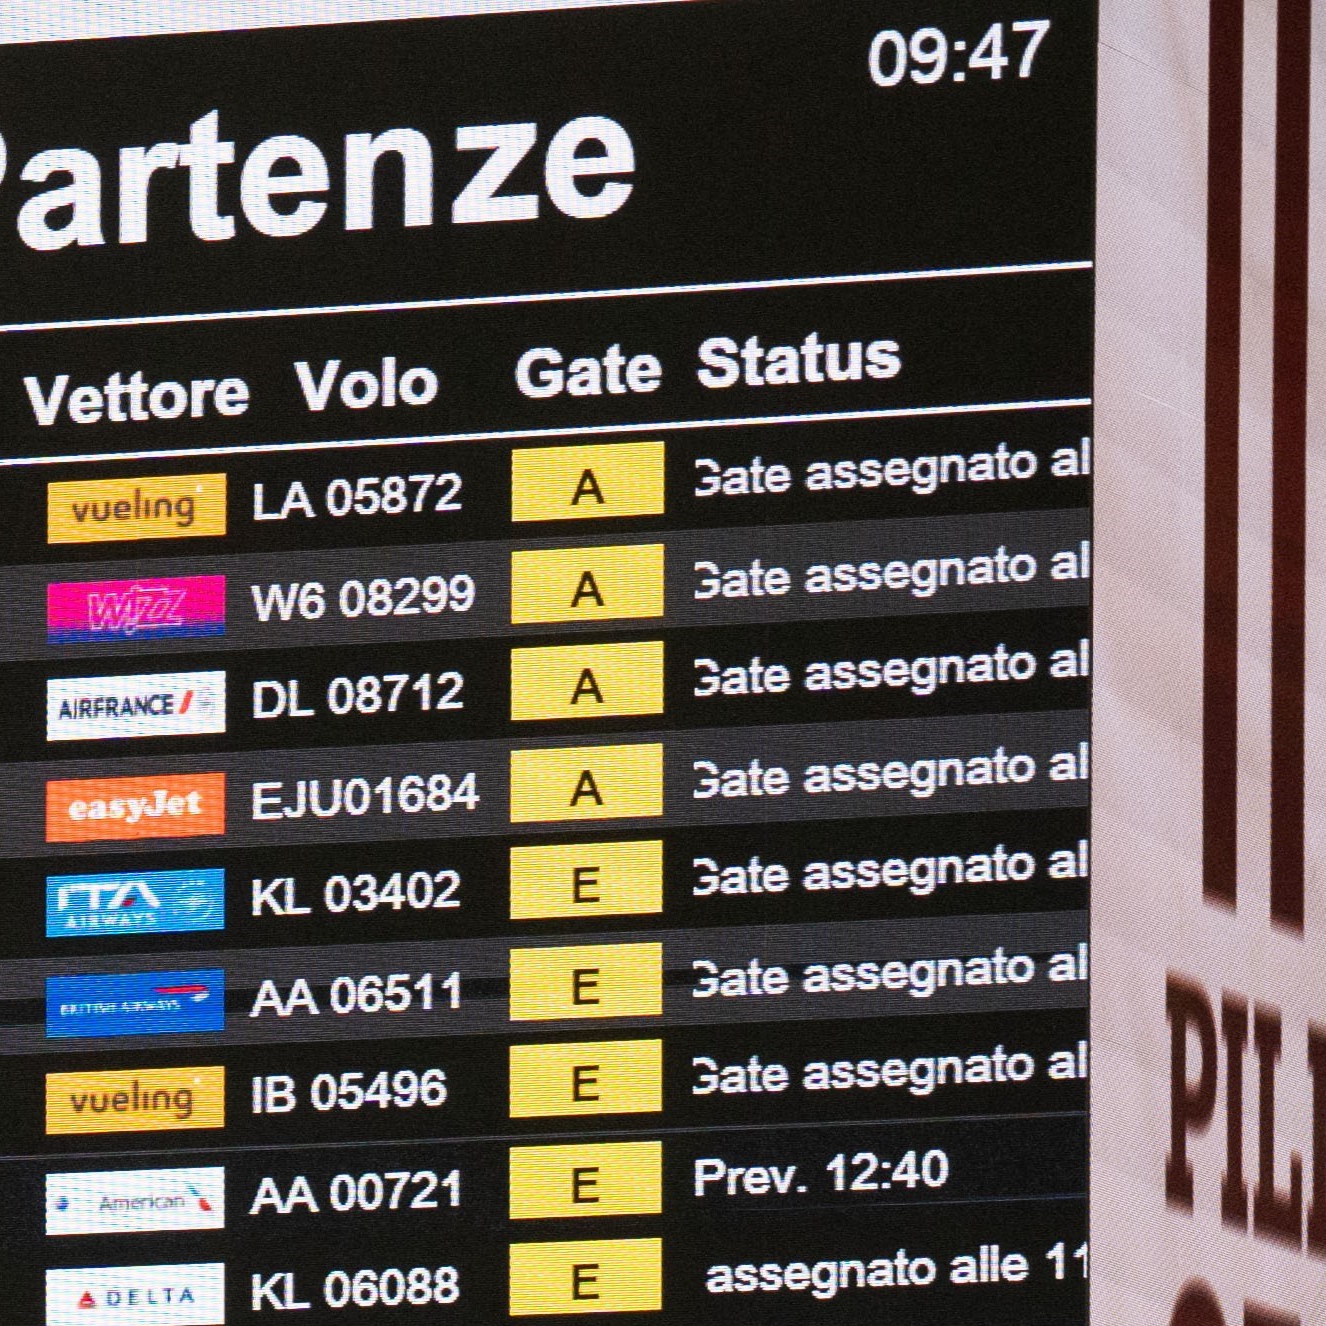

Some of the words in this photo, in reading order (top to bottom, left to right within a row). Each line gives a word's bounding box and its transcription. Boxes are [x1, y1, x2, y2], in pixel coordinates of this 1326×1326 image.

[869, 20, 1050, 86] 09:47
[516, 344, 662, 398] Gate
[698, 332, 901, 388] Status
[24, 371, 249, 425] Vettore
[294, 357, 438, 411] Volo
[254, 482, 315, 520] LA
[327, 473, 462, 516] 05872
[573, 470, 603, 504] A
[251, 582, 325, 622] W6
[339, 574, 475, 617] 08299
[254, 680, 314, 718] DL
[328, 672, 463, 714] 08712
[68, 788, 203, 824] easyJet
[253, 772, 480, 820] EJU01684
[253, 878, 311, 916] KL
[325, 870, 460, 912] 03402
[249, 979, 320, 1017] AA
[331, 972, 459, 1014] 06511
[253, 1076, 296, 1113] IB
[311, 1069, 447, 1110] 05496
[249, 1176, 319, 1214] AA
[330, 1170, 459, 1211] 00721
[695, 1159, 806, 1196] Prev.
[827, 1150, 948, 1191] 12:40
[106, 1286, 196, 1307] DELTA
[252, 1273, 310, 1310] KL
[324, 1266, 459, 1308] 06088
